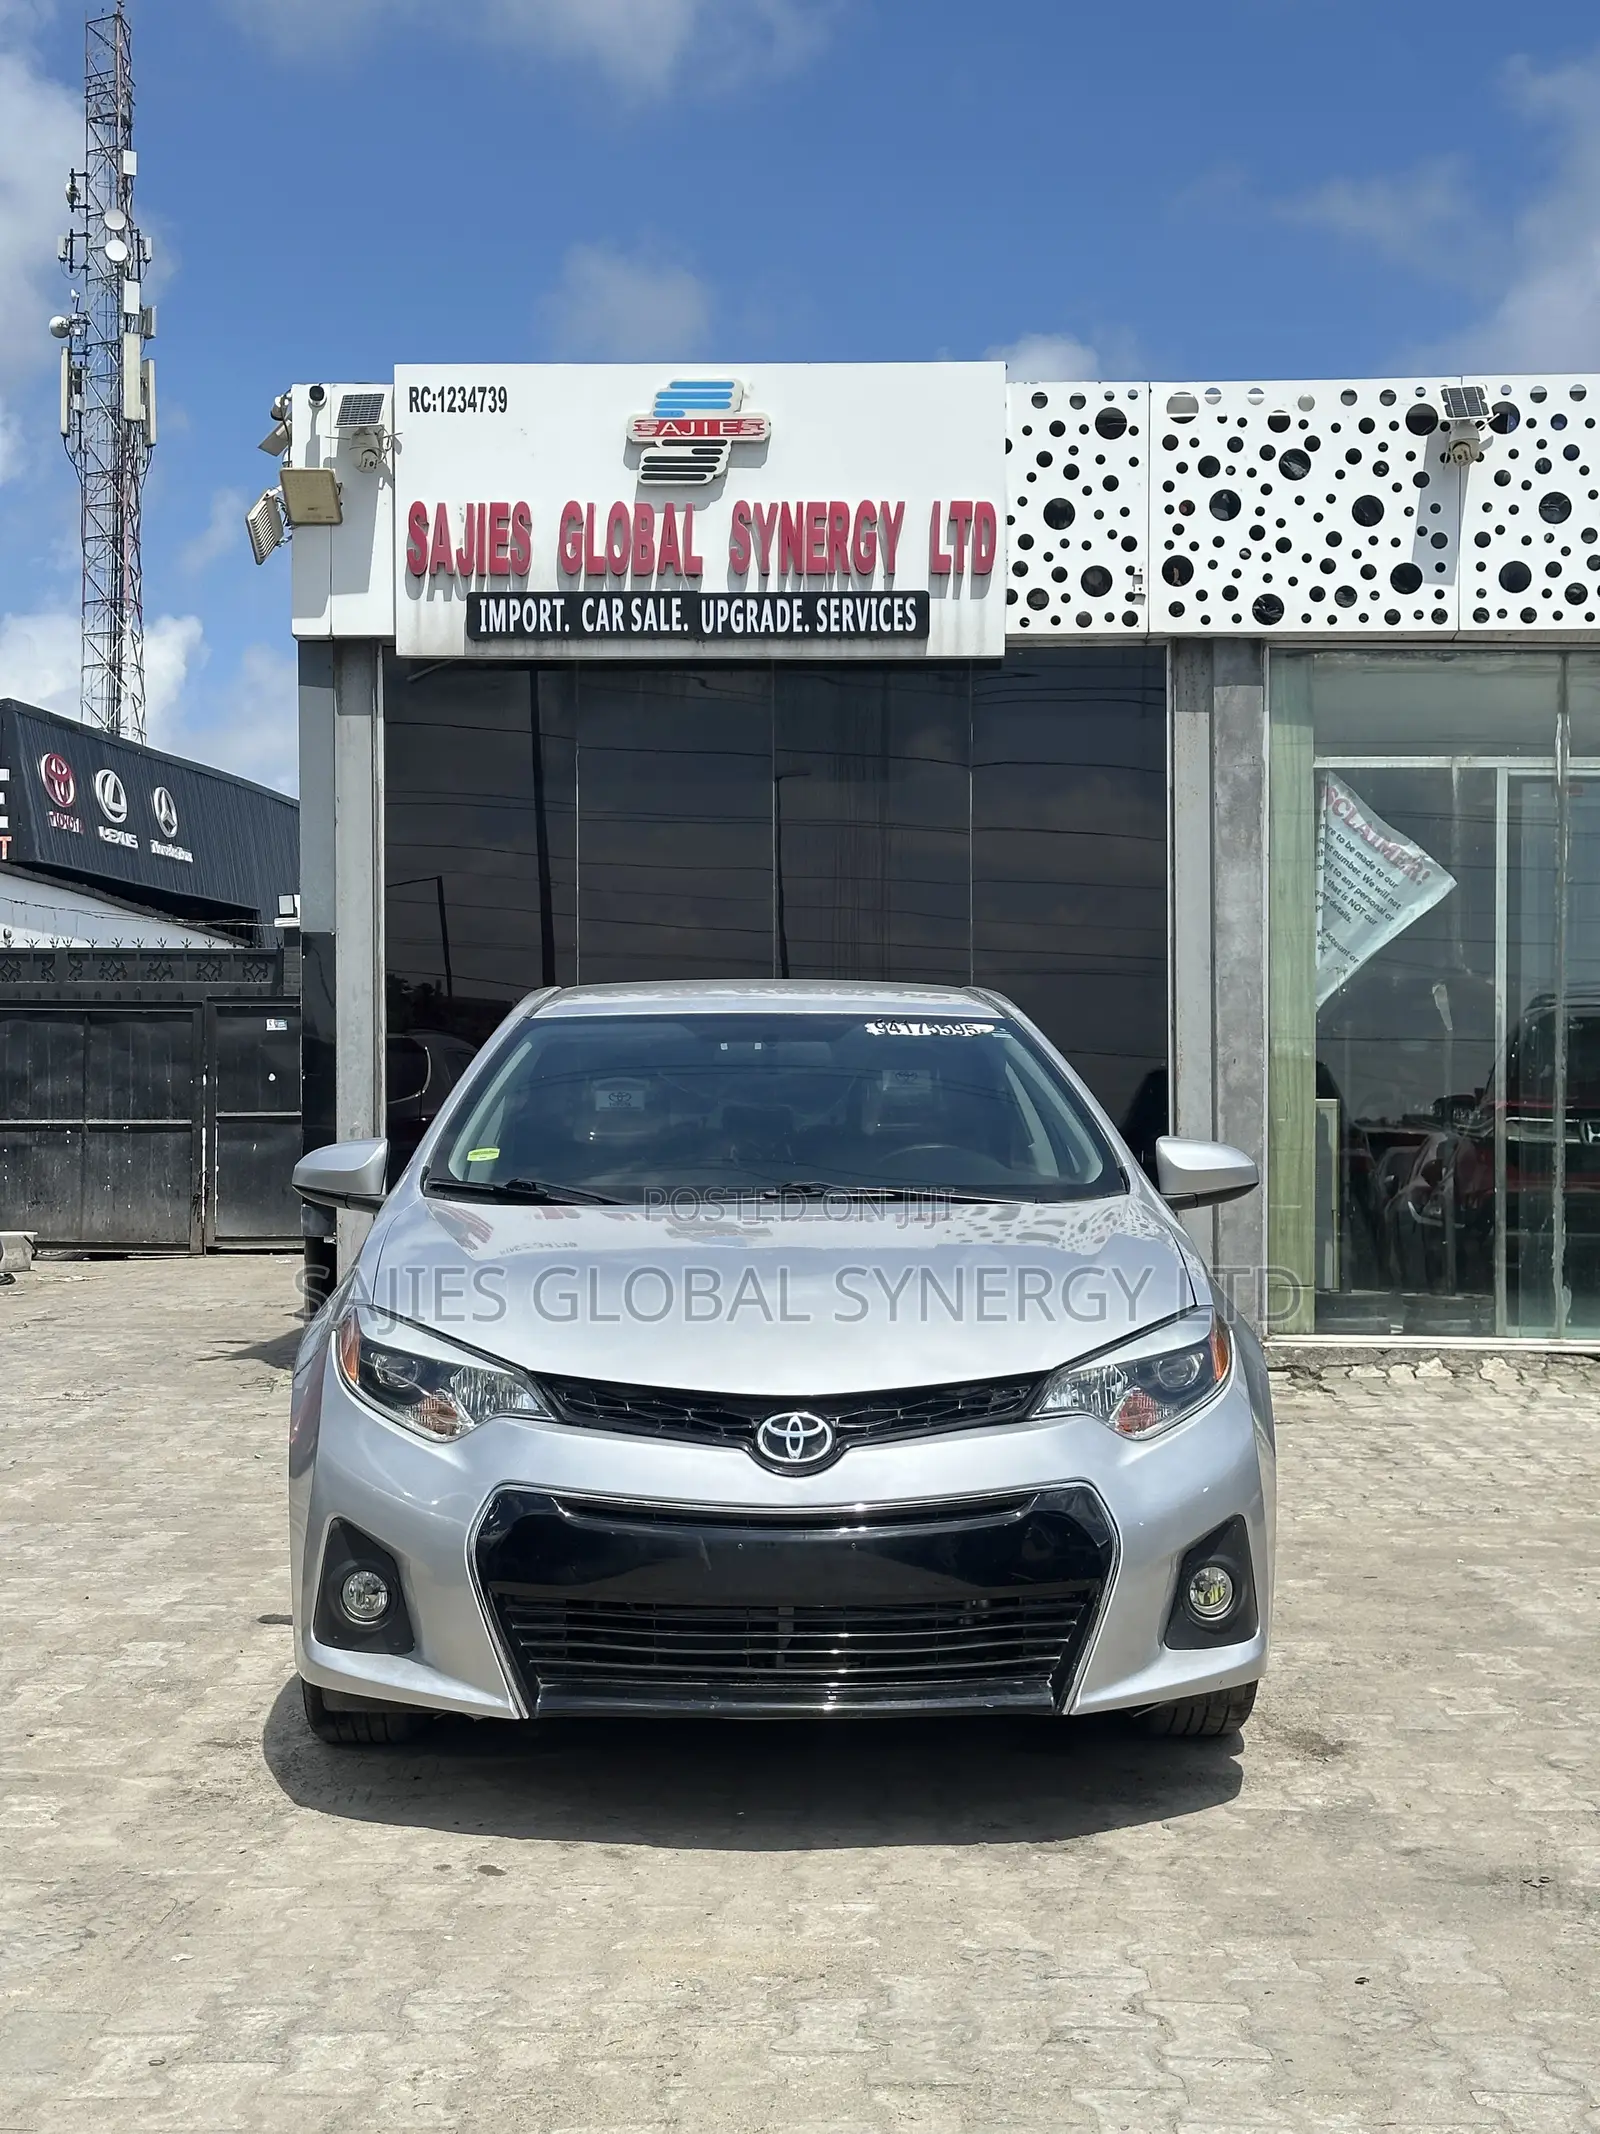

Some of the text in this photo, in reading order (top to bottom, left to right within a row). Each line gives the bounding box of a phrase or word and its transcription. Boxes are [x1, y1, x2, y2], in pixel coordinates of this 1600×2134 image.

[408, 386, 508, 413] RC:1234739
[633, 418, 765, 437] SAJIES
[406, 500, 997, 577] SAJIES GLOBAL SYNERGY LTD
[479, 597, 917, 634] IMPORT. CAR SALE. UPGRADE. SERVICES
[1336, 834, 1345, 844] to
[1345, 841, 1355, 852] be
[1355, 851, 1376, 870] made
[1376, 868, 1385, 878] to
[1384, 877, 1399, 889] our
[1333, 868, 1341, 878] to
[1341, 877, 1356, 889] any
[1354, 888, 1387, 915] personal
[1341, 892, 1348, 901] is
[1348, 898, 1367, 914] NOT
[1364, 914, 1378, 926] our
[1362, 874, 1375, 887] We
[1375, 886, 1389, 899] will
[1388, 898, 1402, 910] not
